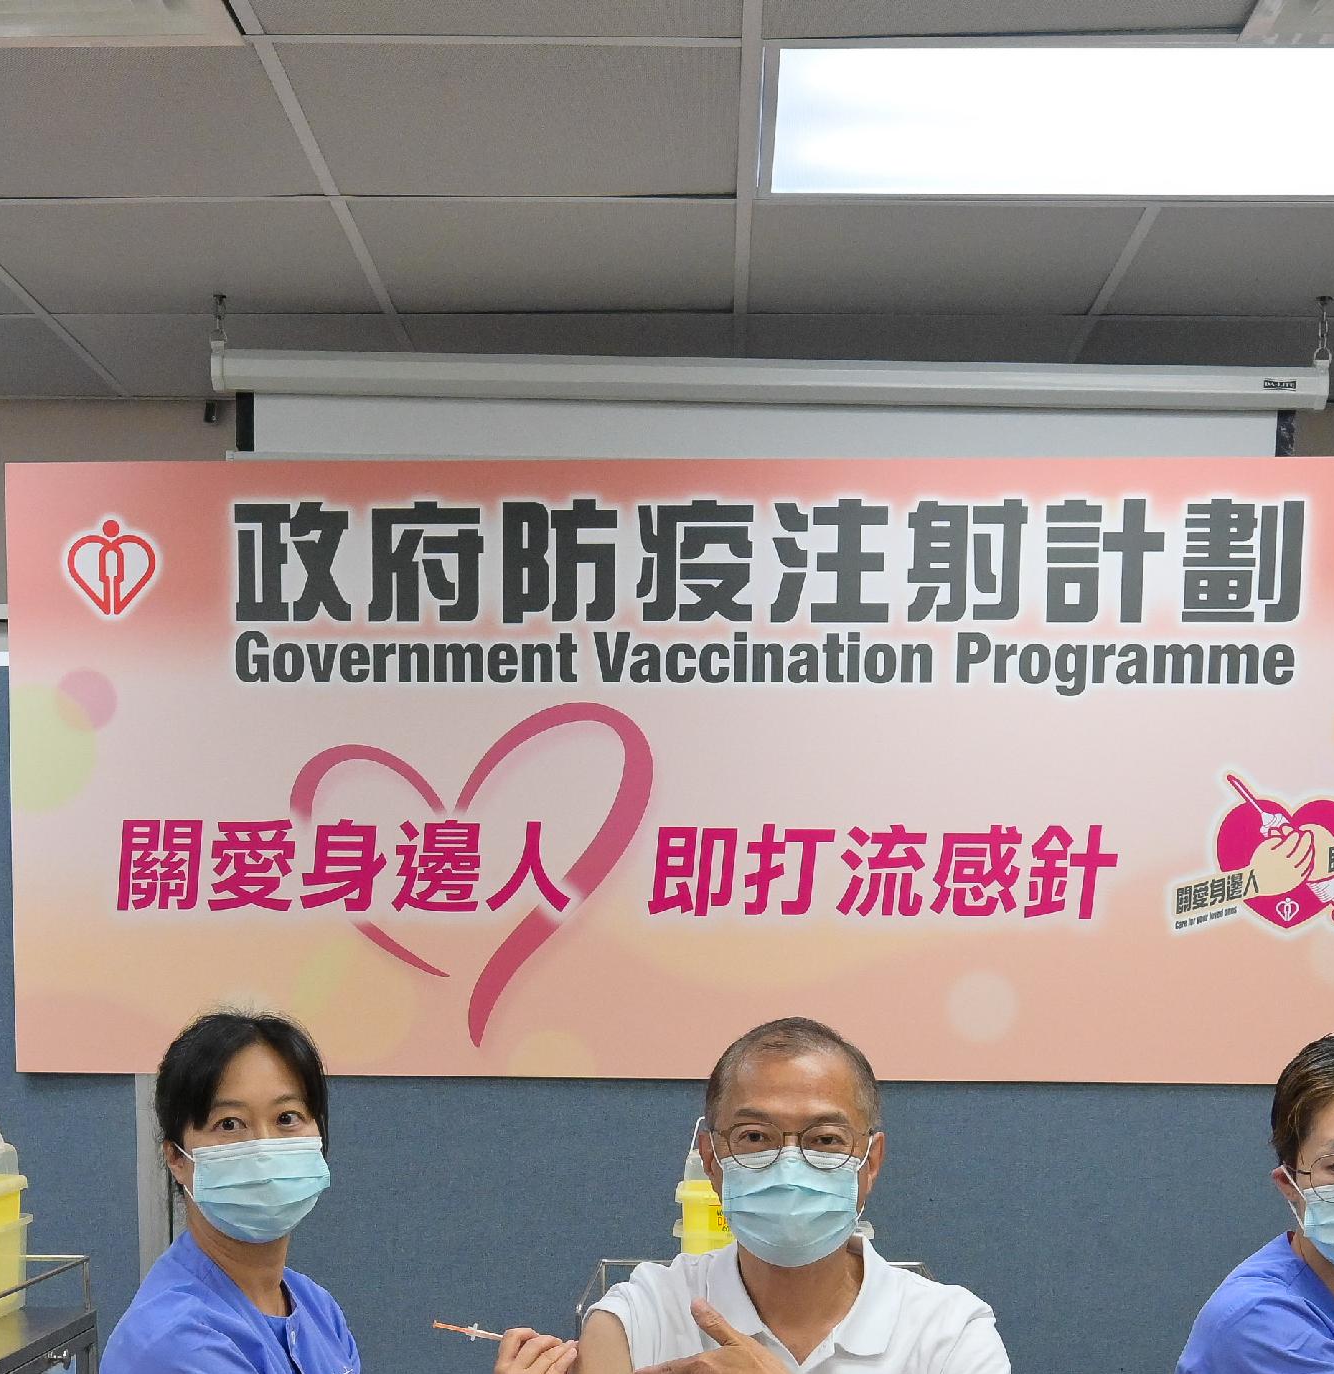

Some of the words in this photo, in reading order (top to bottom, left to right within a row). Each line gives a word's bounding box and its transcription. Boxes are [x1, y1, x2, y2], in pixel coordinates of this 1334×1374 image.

[233, 498, 1305, 624] 政府防疫注射計劃
[234, 631, 577, 684] Government
[595, 631, 933, 685] Vaccination
[956, 633, 1296, 697] Programme
[116, 818, 572, 913] 關愛身邊人
[647, 823, 1119, 920] 即打流感針
[1176, 868, 1259, 914] 關愛身邊人
